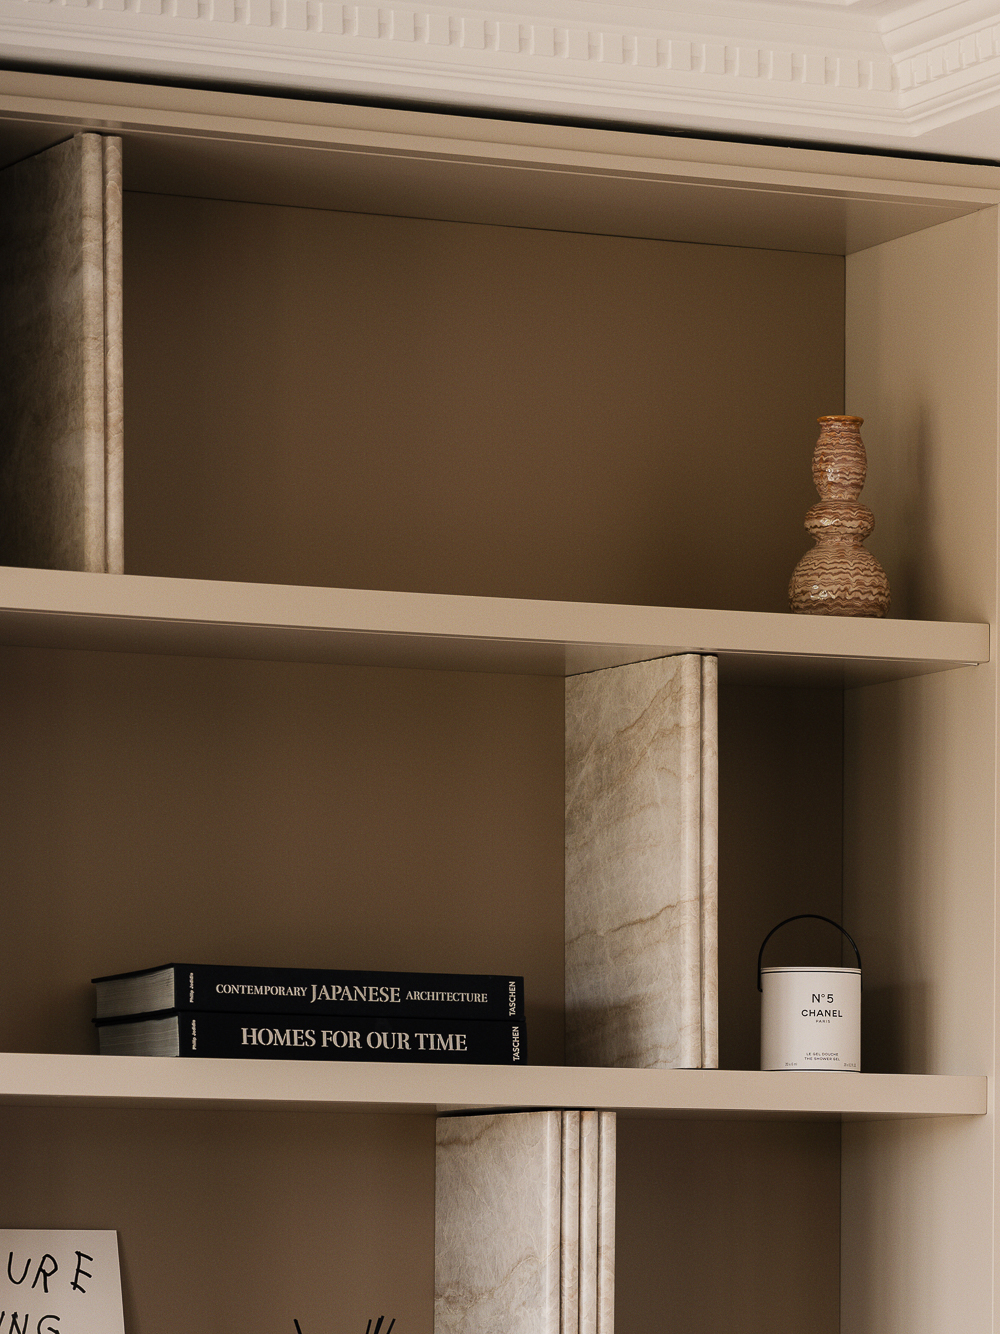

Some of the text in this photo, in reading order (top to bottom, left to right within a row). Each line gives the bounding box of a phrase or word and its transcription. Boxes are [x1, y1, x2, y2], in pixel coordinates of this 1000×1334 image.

[215, 984, 488, 1003] CONTEMPORARY JAPANESE ARCHITECTURE
[508, 981, 516, 1016] TASCHEN
[801, 1009, 843, 1017] CHANEL
[241, 1027, 468, 1051] HOMES FOR OUR TIME
[512, 1026, 520, 1061] TASCHEN
[8, 1251, 93, 1293] URE
